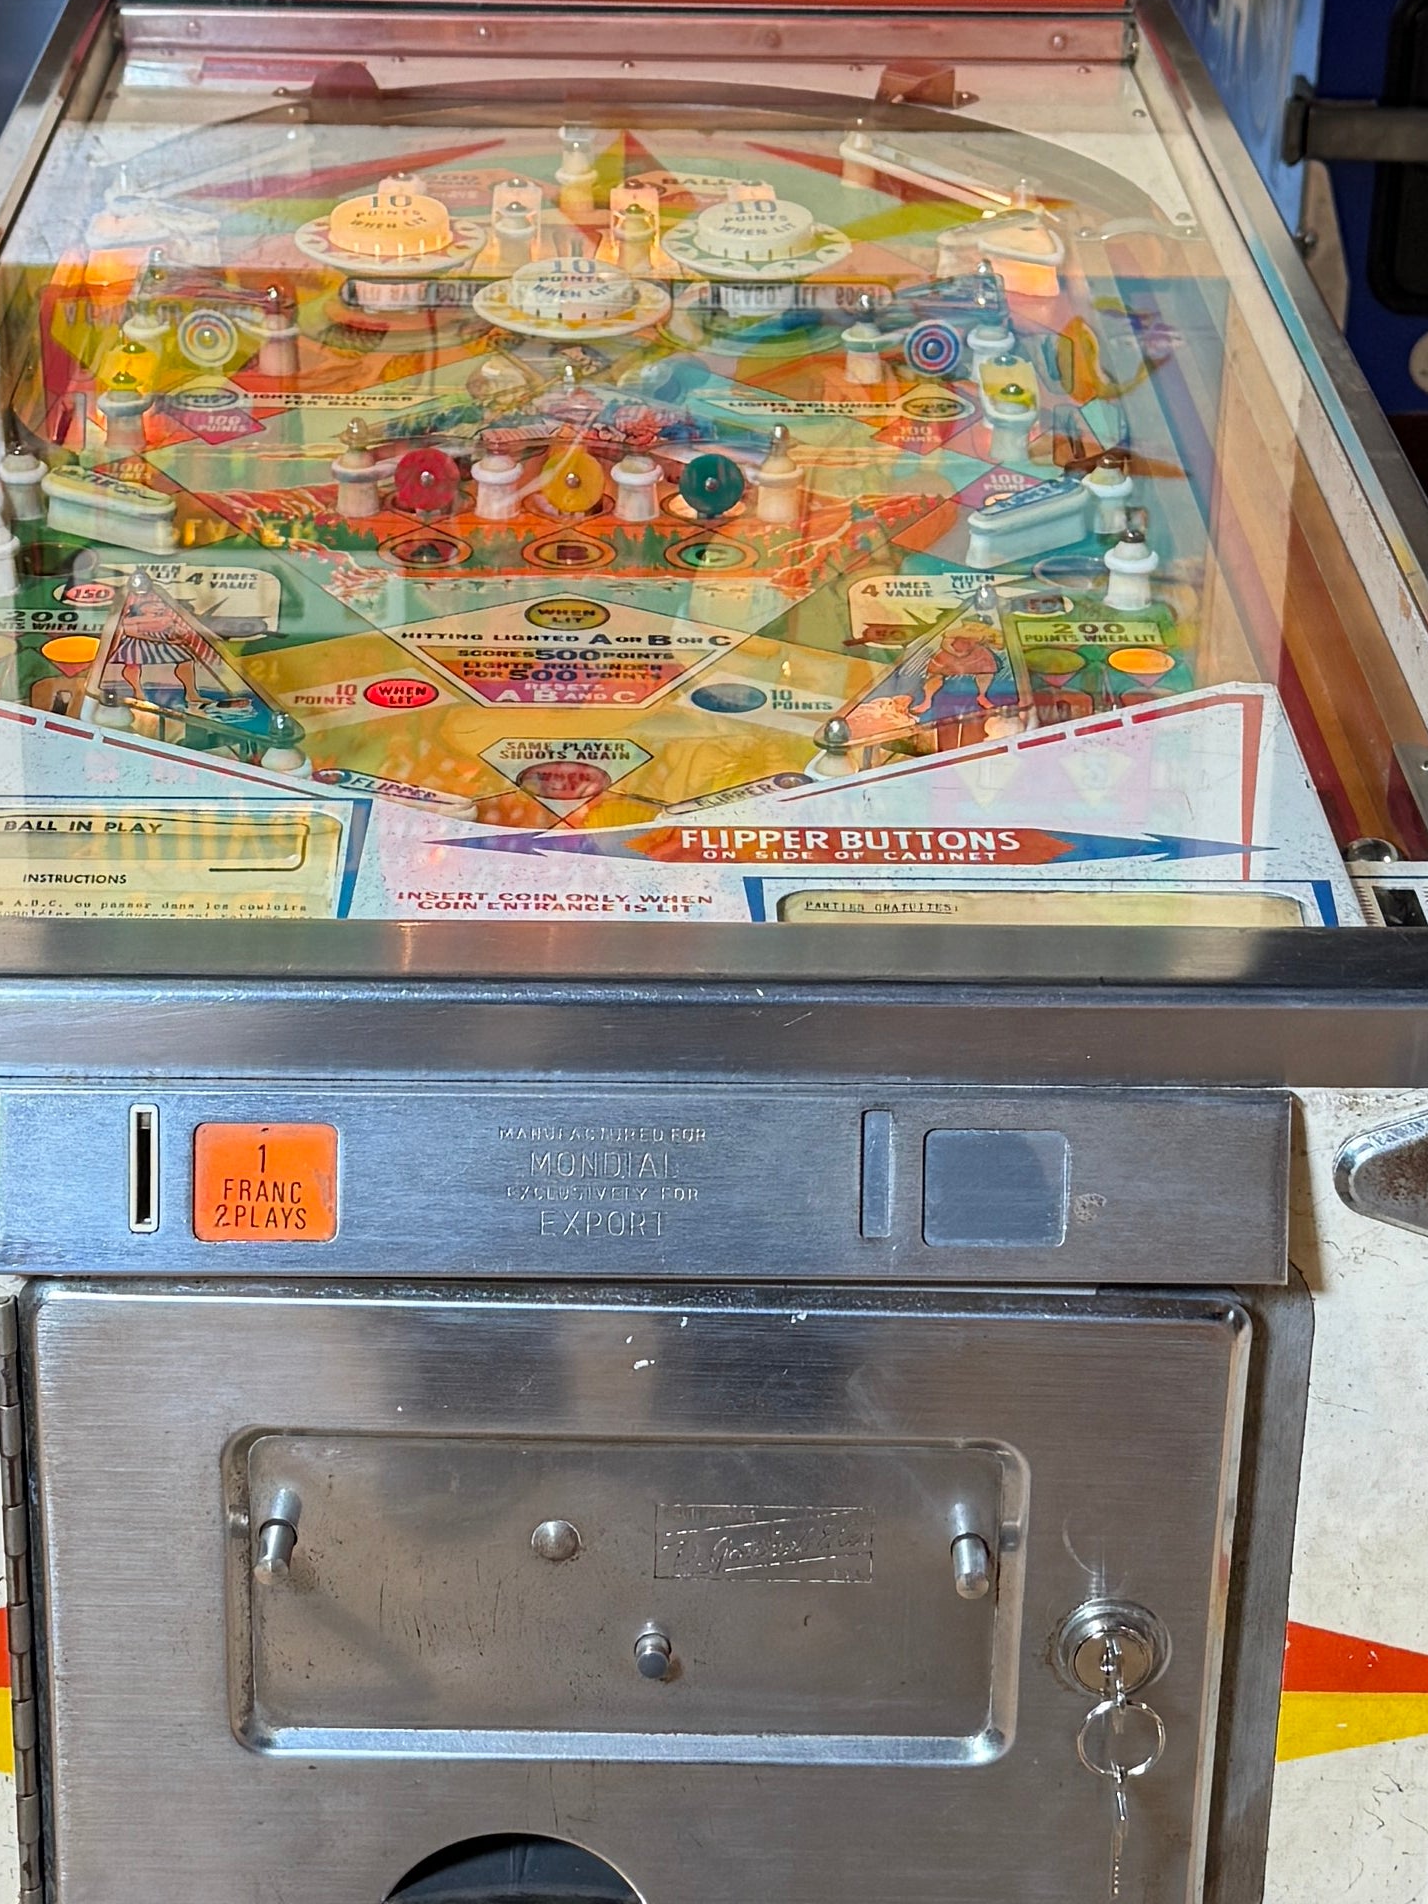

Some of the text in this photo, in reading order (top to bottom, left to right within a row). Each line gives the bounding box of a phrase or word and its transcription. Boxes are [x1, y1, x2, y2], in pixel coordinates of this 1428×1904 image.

[371, 195, 413, 208] 10
[733, 200, 778, 214] 10
[355, 209, 422, 219] POINTS
[724, 214, 788, 224] POINTS
[350, 216, 428, 231] WHEN LIT
[719, 222, 797, 236] WHEN LIT
[550, 258, 597, 274] 10
[538, 275, 608, 284] POINTS
[533, 284, 585, 299] WHEN
[591, 282, 622, 297] LIT
[243, 393, 304, 401] LIGHTS
[728, 400, 788, 408] LIGHTS
[208, 415, 242, 425] 100
[185, 572, 204, 584] 4
[210, 573, 259, 582] TIMES
[950, 573, 996, 583] WHEN
[210, 581, 258, 590] VALUE
[861, 582, 931, 598] 4 TIMES
[885, 589, 934, 598] VALUE
[5, 610, 79, 623] 200
[538, 608, 596, 617] WHEN
[552, 616, 585, 624] LIT
[32, 622, 77, 632] WHEN
[1052, 623, 1126, 635] 200
[401, 632, 732, 647] HITTING LIGHTED A B C
[1025, 634, 1157, 643] POINTS WHEN LIT
[457, 649, 675, 661] SCORES 500 POINTS
[462, 662, 664, 672] LIGHTS ROLLUNDER
[463, 670, 662, 682] FOR 500 POINTS
[336, 684, 428, 698] 10 WHEN
[524, 682, 606, 691] RESETS
[494, 690, 637, 703] A B AND C
[770, 688, 793, 701] 10
[293, 695, 413, 707] POINTS LIT
[770, 699, 834, 711] POINTS
[505, 741, 626, 753] SAME PLAYER
[500, 750, 631, 761] SHOOTS AGAIN
[351, 776, 437, 799] FLIPPER
[694, 783, 776, 808] FLIPPER
[4, 820, 163, 835] BALL IN PLAY
[682, 829, 1021, 852] FLIPPER BUTTONS
[702, 850, 998, 862] ON SIDE OF CABINET
[22, 873, 128, 885] INSTRUCTIONS
[397, 891, 714, 905] INSERT COIN ONLY WHEN
[417, 900, 692, 914] COIN ENTRANCE IS LIT
[672, 1127, 708, 1143] FOR
[258, 1144, 267, 1174] 1
[529, 1151, 679, 1179] MONDIAL
[223, 1178, 303, 1205] FRANC
[661, 1187, 699, 1202] FOR
[539, 1209, 670, 1238] EXPORT
